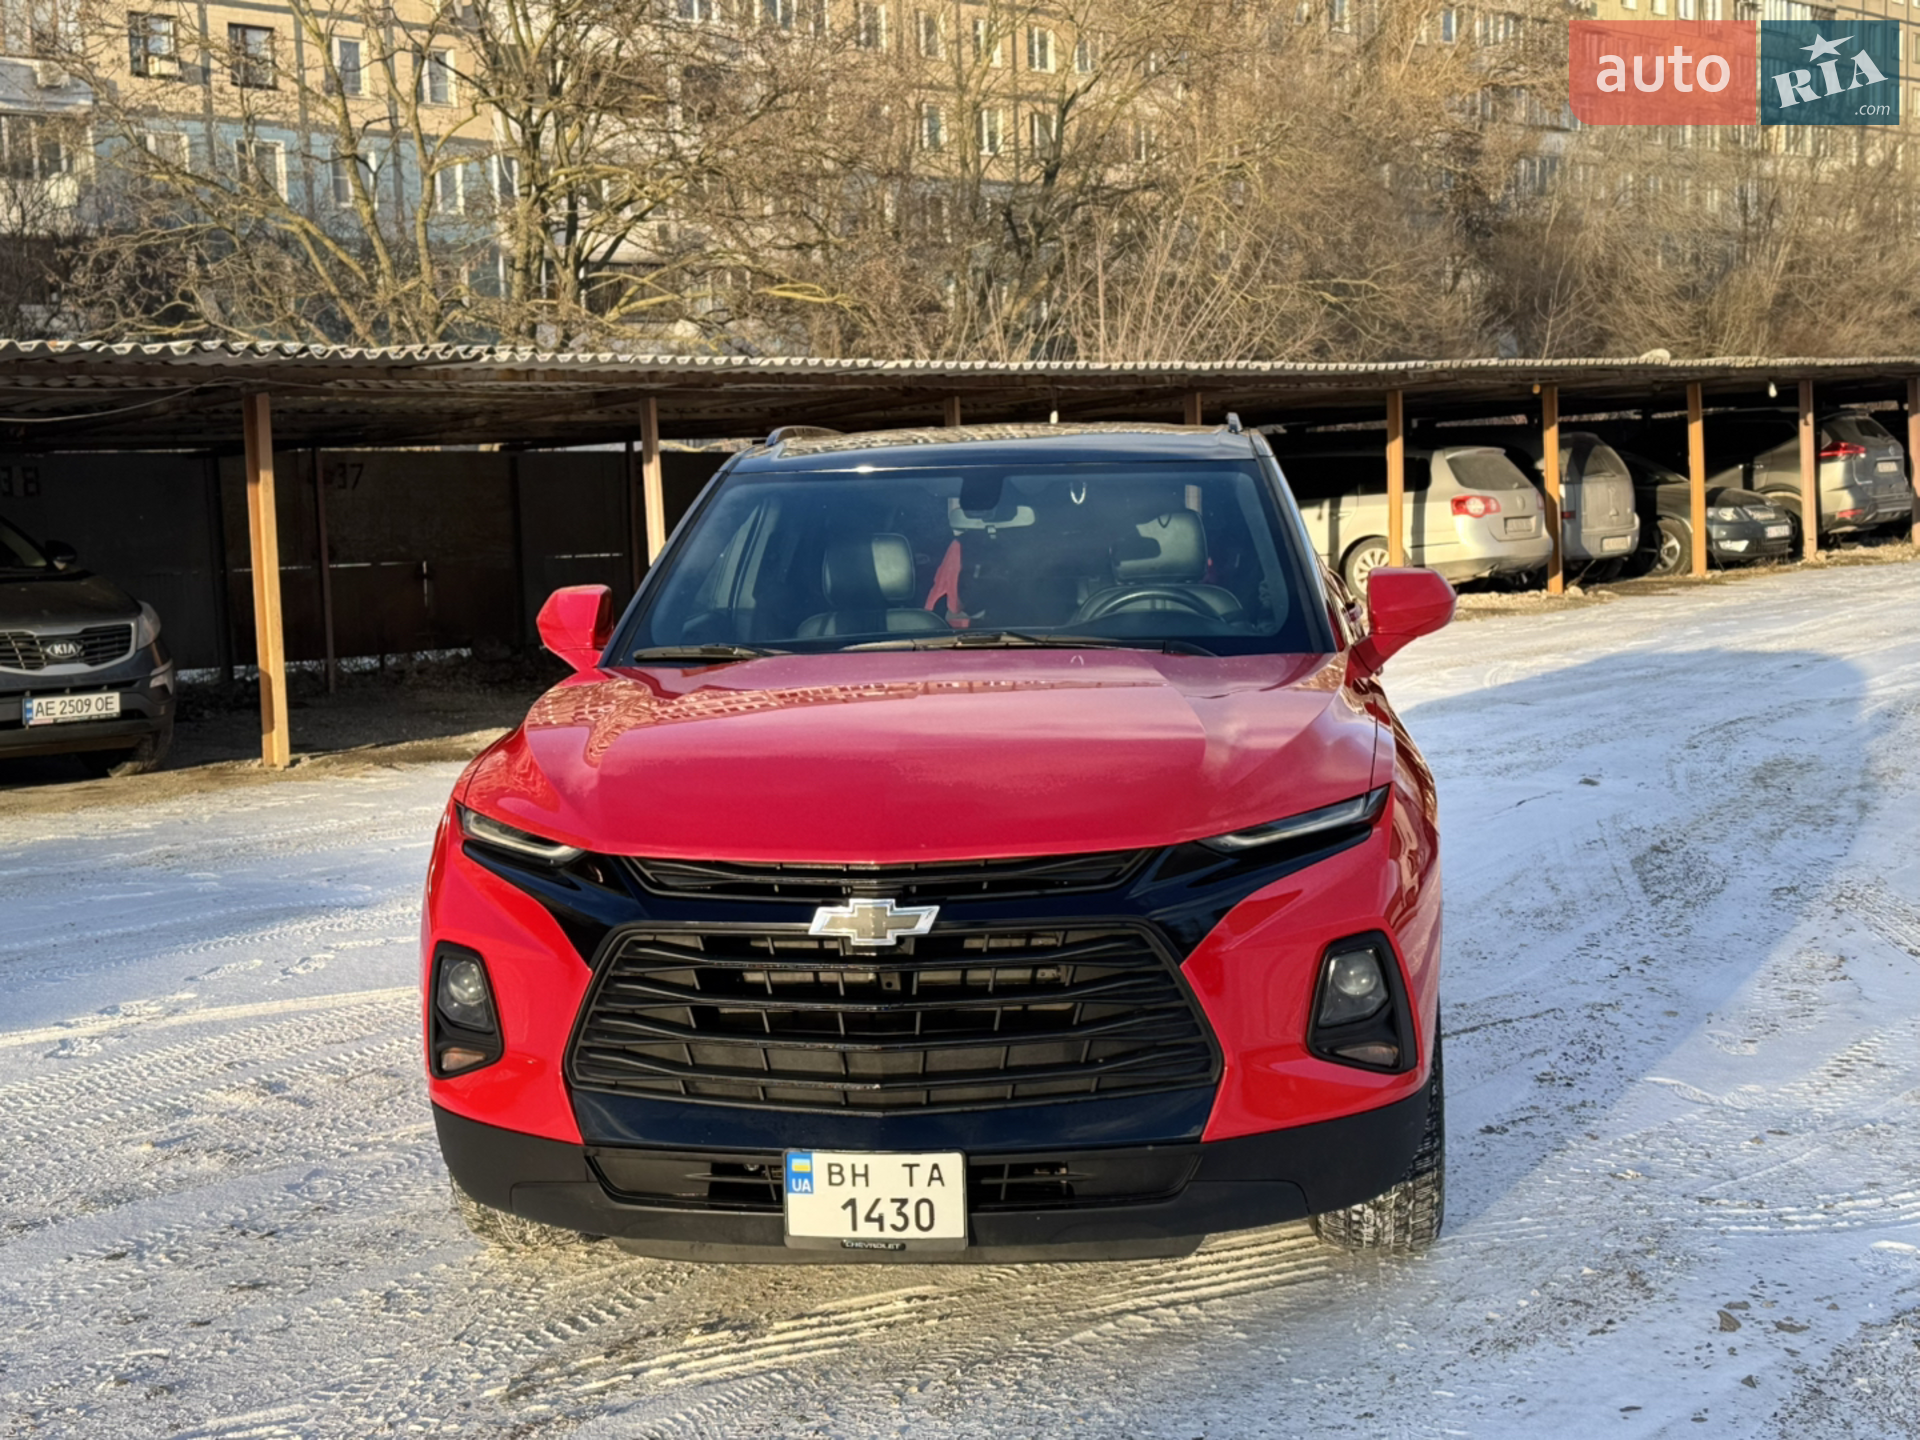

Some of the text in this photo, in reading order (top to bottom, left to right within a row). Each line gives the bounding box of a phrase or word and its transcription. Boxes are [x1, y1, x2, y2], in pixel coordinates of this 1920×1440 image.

[337, 463, 364, 490] 37
[53, 643, 77, 655] KIA
[35, 701, 56, 717] AE
[59, 699, 92, 715] 2509
[95, 696, 115, 712] OE
[791, 1178, 812, 1192] UA
[827, 1163, 945, 1187] BH TA
[841, 1198, 935, 1232] 1430
[845, 1240, 901, 1250] CHEVROLET
